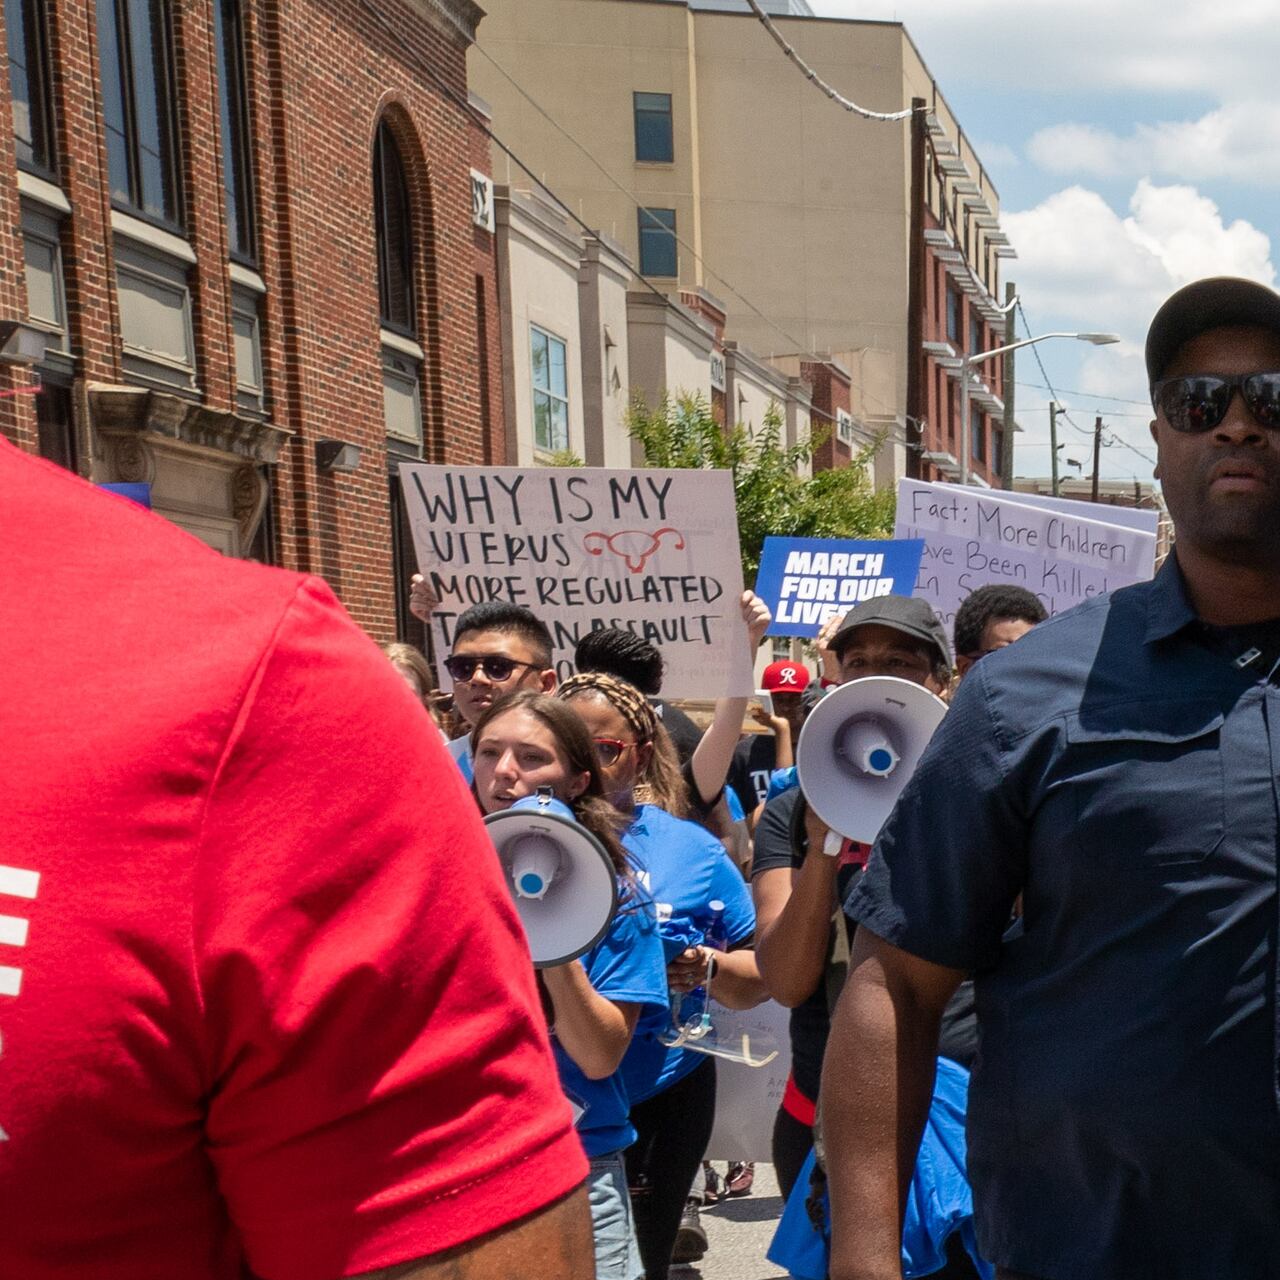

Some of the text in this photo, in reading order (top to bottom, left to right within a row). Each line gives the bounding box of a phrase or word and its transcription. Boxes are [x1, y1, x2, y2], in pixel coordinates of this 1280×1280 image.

[412, 472, 672, 525] WHY IS MY
[912, 491, 1126, 562] Fact: More Children
[429, 531, 571, 567] UTERUS
[785, 551, 884, 576] MARCH
[966, 541, 1027, 580] Been
[429, 571, 723, 608] MORE REGULATED
[779, 576, 894, 600] FOR OUR
[779, 667, 797, 685] R
